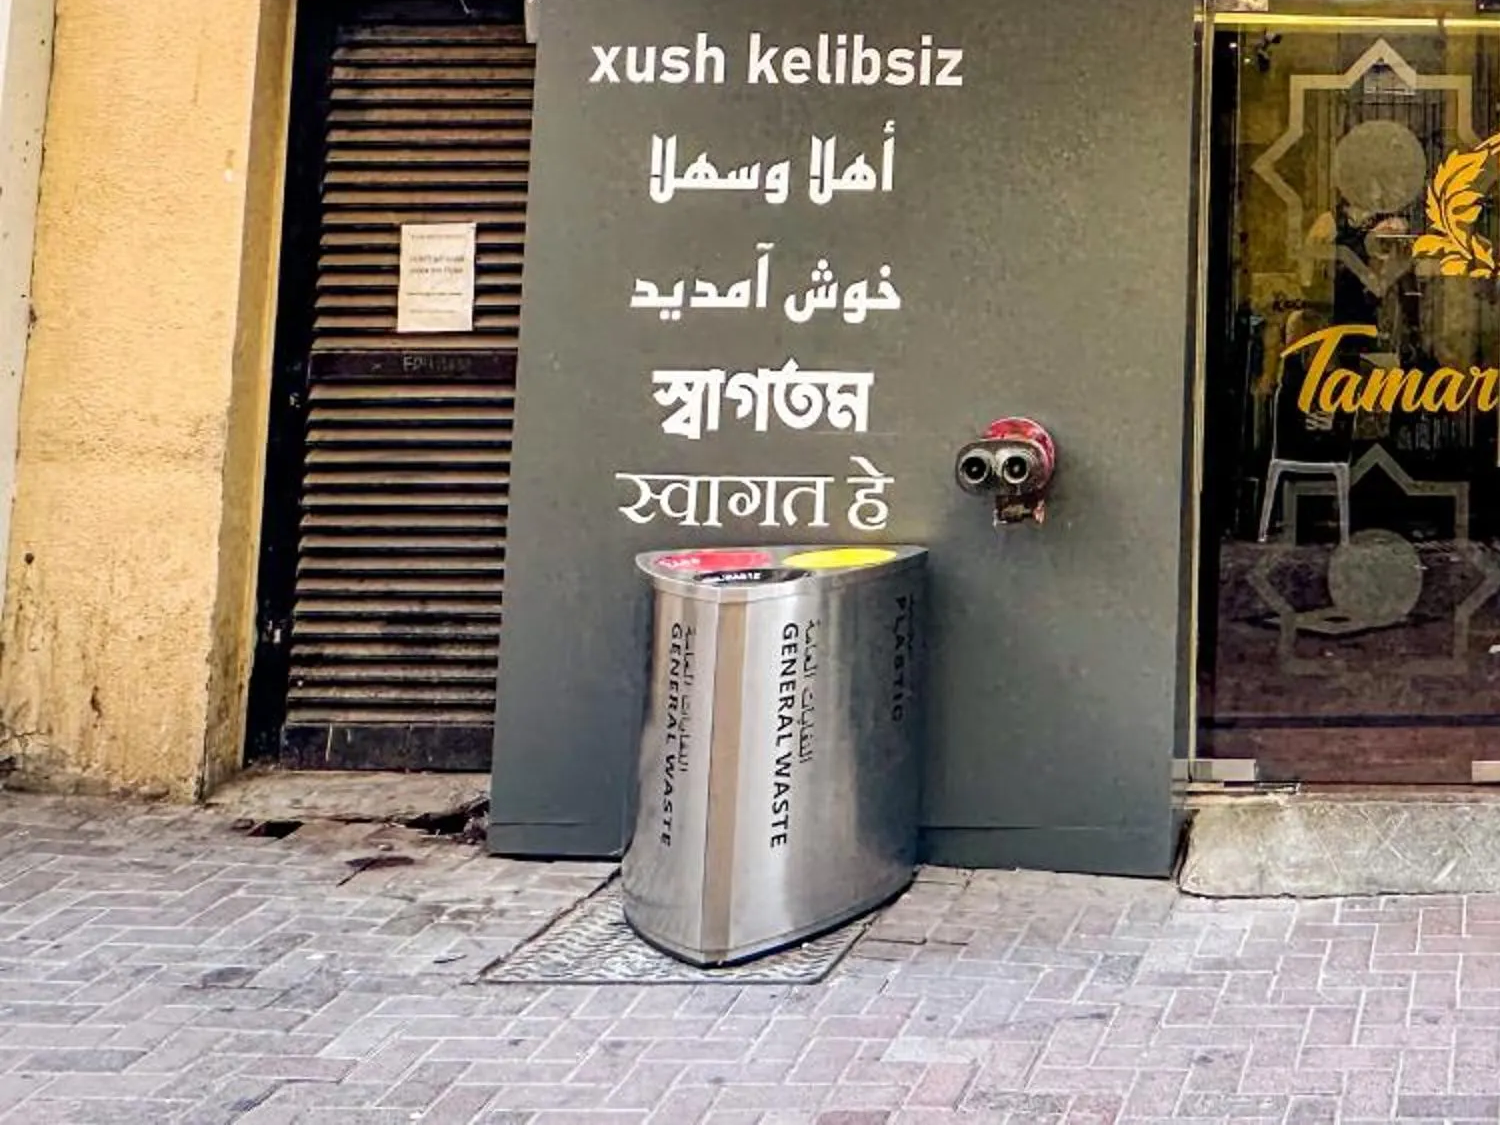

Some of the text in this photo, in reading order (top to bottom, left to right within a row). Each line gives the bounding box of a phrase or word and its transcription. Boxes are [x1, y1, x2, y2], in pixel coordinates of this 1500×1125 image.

[589, 32, 963, 86] xush kelibsiz
[649, 120, 895, 205] أهلا وسهلا
[783, 259, 901, 324] خوش
[615, 455, 896, 532] स्वागत हे
[660, 622, 683, 848] GENERAL WASTE
[770, 622, 799, 849] GENERAL WASTE
